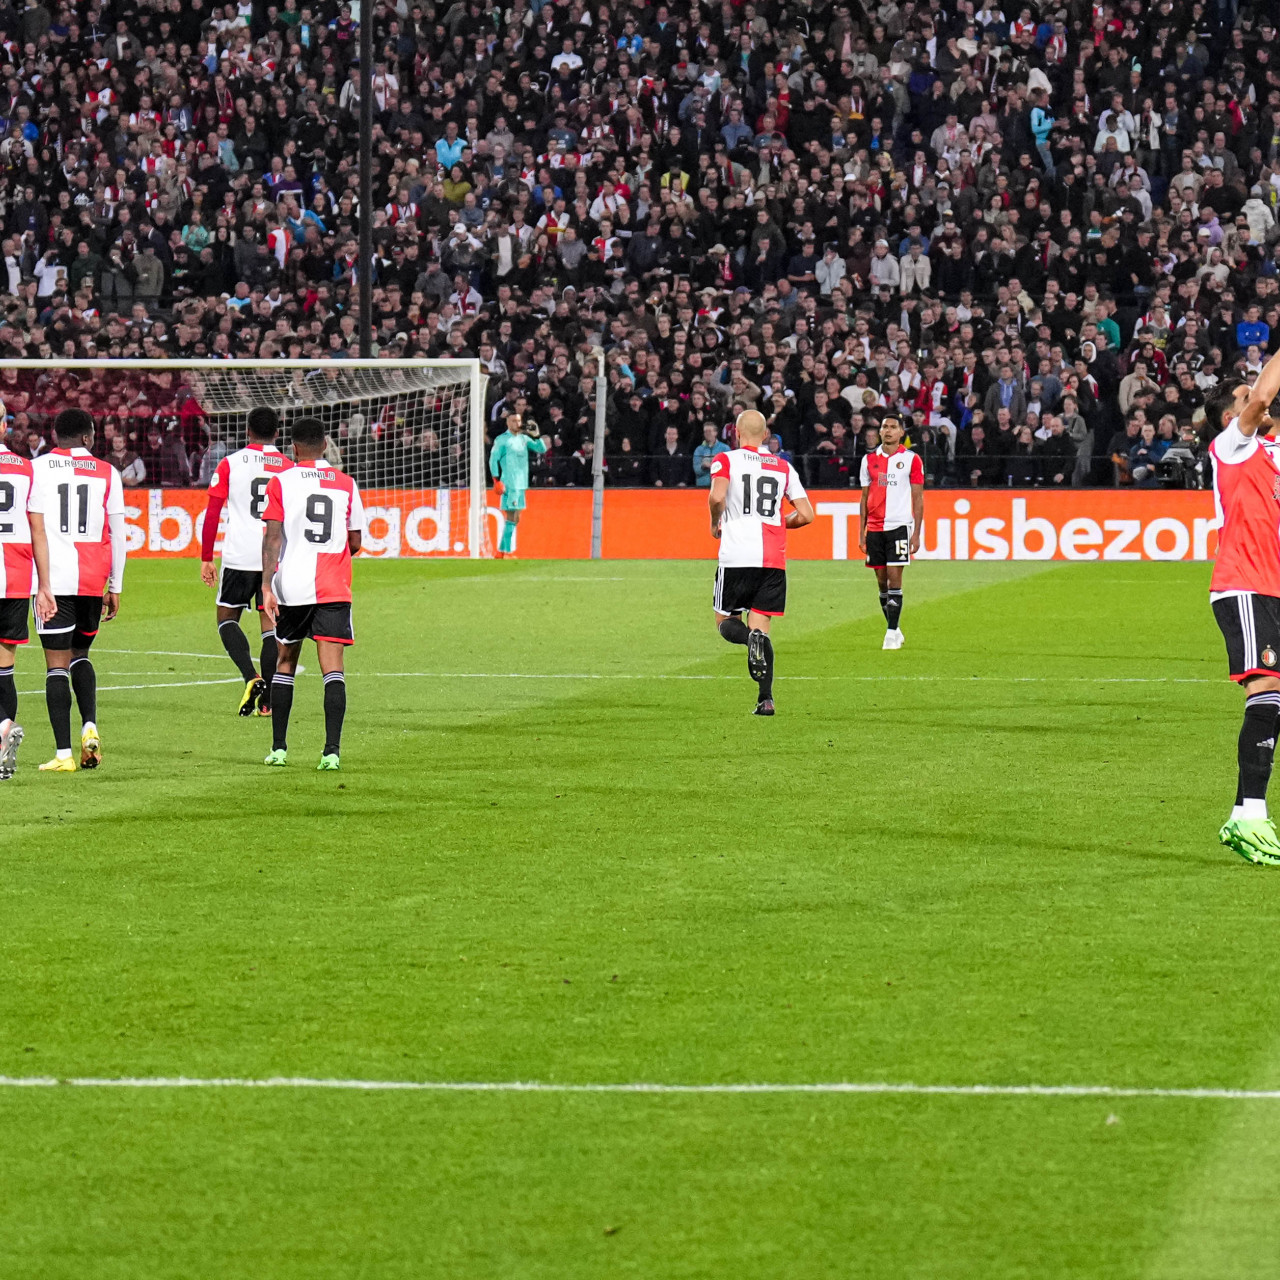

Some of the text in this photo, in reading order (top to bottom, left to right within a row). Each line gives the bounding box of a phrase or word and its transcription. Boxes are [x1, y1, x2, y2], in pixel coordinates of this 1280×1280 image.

[57, 482, 90, 536] 11
[250, 477, 270, 520] 8
[741, 473, 780, 518] 18
[304, 493, 334, 545] 9
[895, 540, 908, 555] 15
